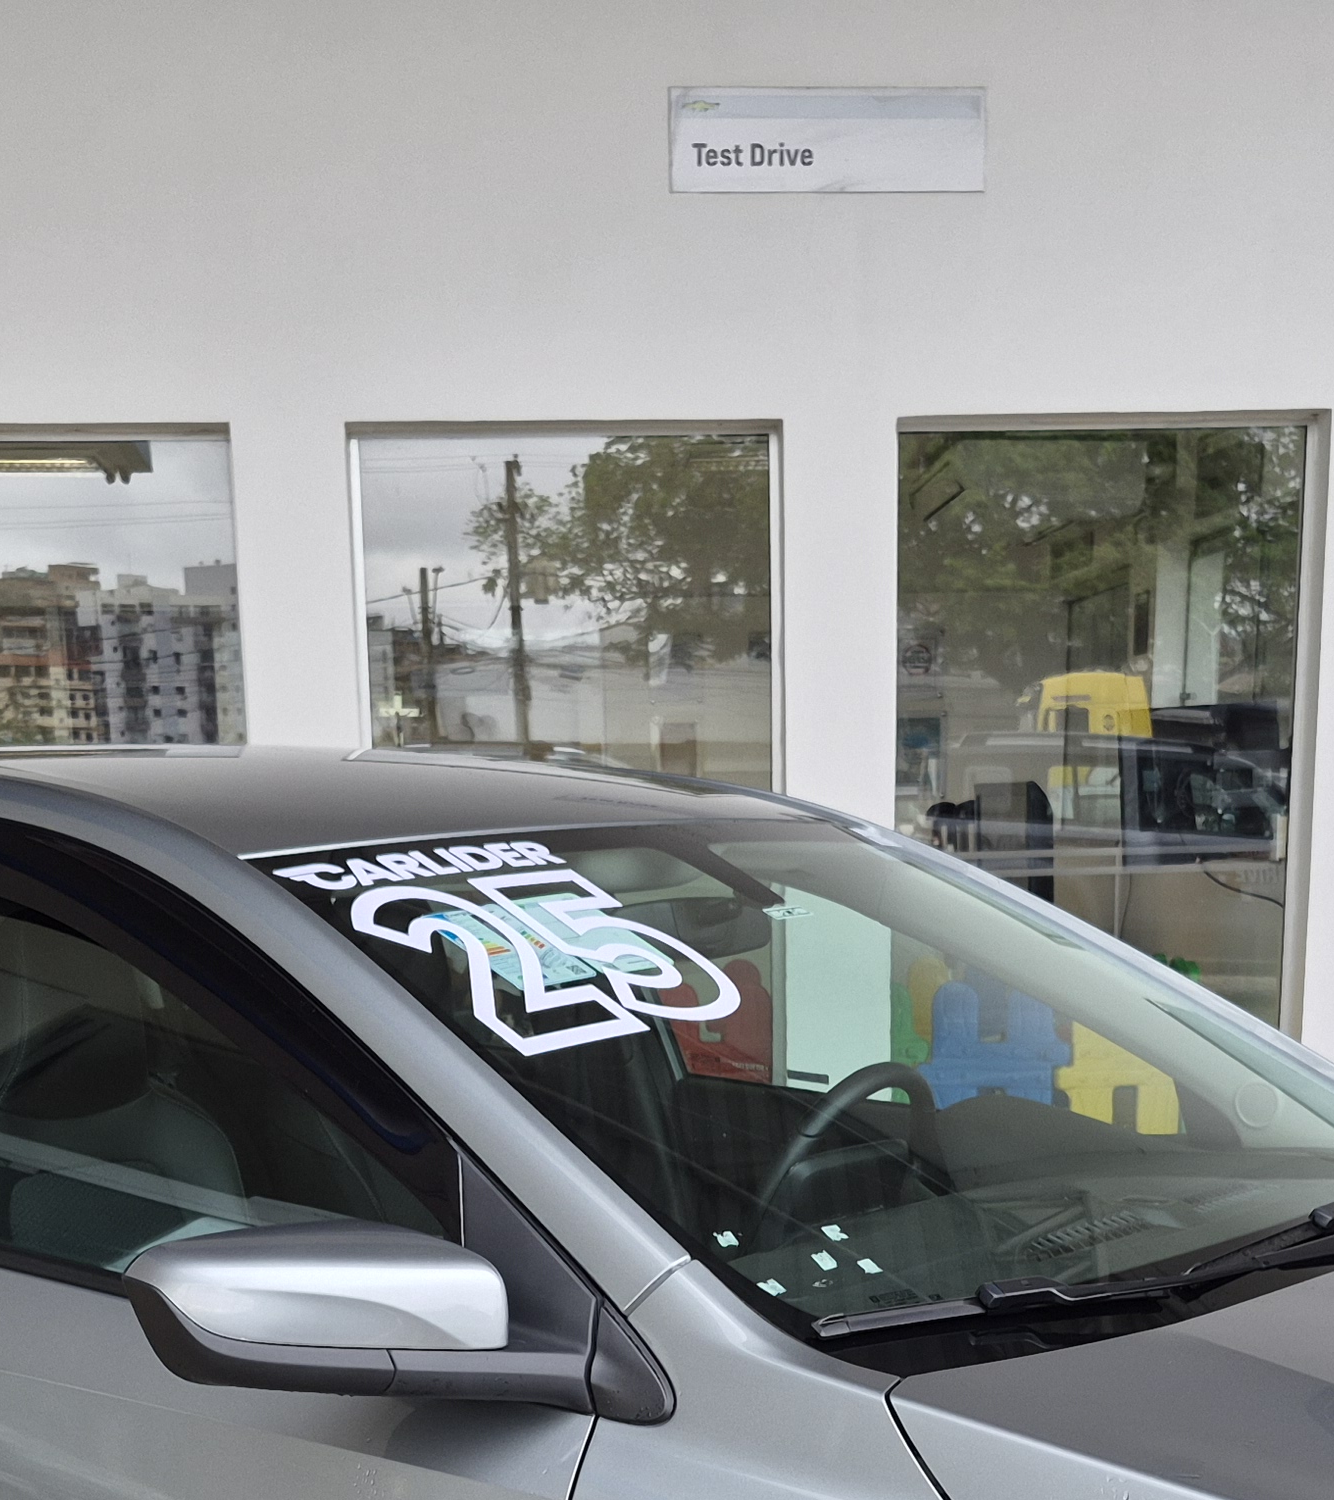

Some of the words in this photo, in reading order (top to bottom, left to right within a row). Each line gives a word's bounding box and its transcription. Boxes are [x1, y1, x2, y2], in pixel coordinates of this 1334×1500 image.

[691, 142, 744, 167] Test
[750, 142, 815, 167] Drive
[273, 841, 567, 890] CARLIDER
[350, 869, 742, 1056] 25
